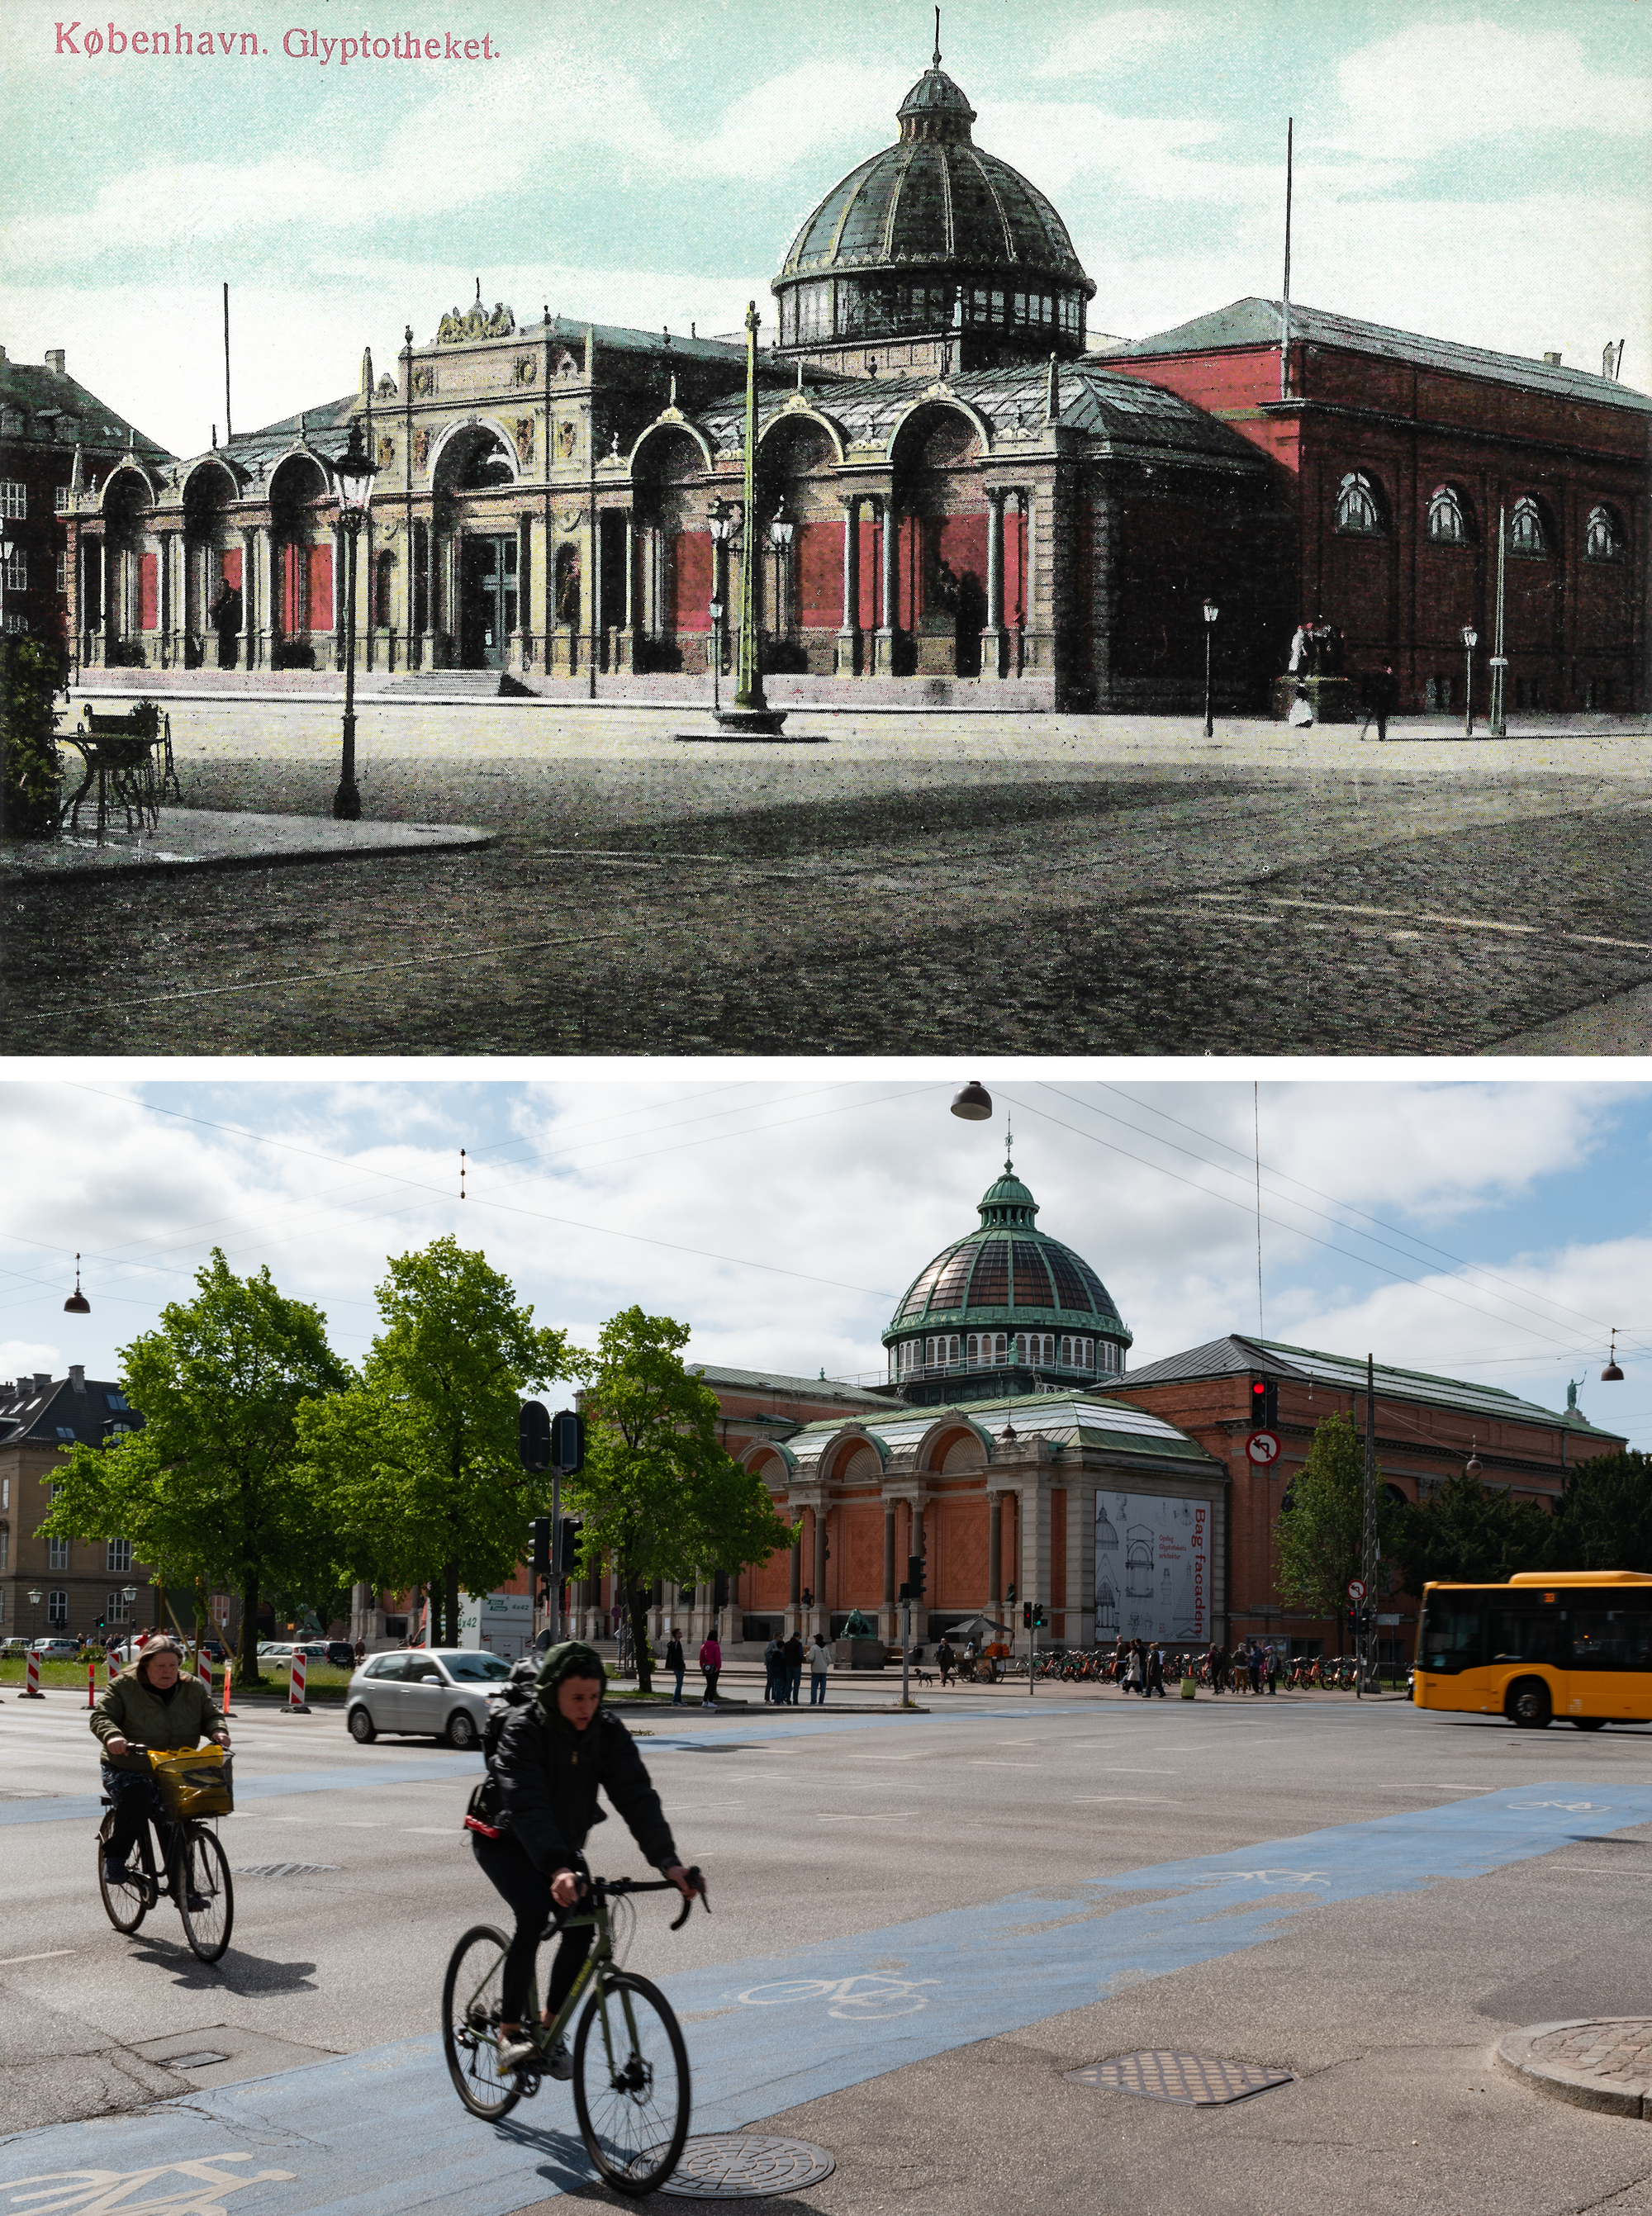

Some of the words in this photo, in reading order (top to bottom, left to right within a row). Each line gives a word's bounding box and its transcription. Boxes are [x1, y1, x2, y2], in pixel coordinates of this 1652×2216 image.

[1159, 1535, 1174, 1544] Opdag
[1191, 1509, 1205, 1549] Bag
[1195, 1554, 1206, 1634] facaden
[458, 1617, 477, 1628] 4x42
